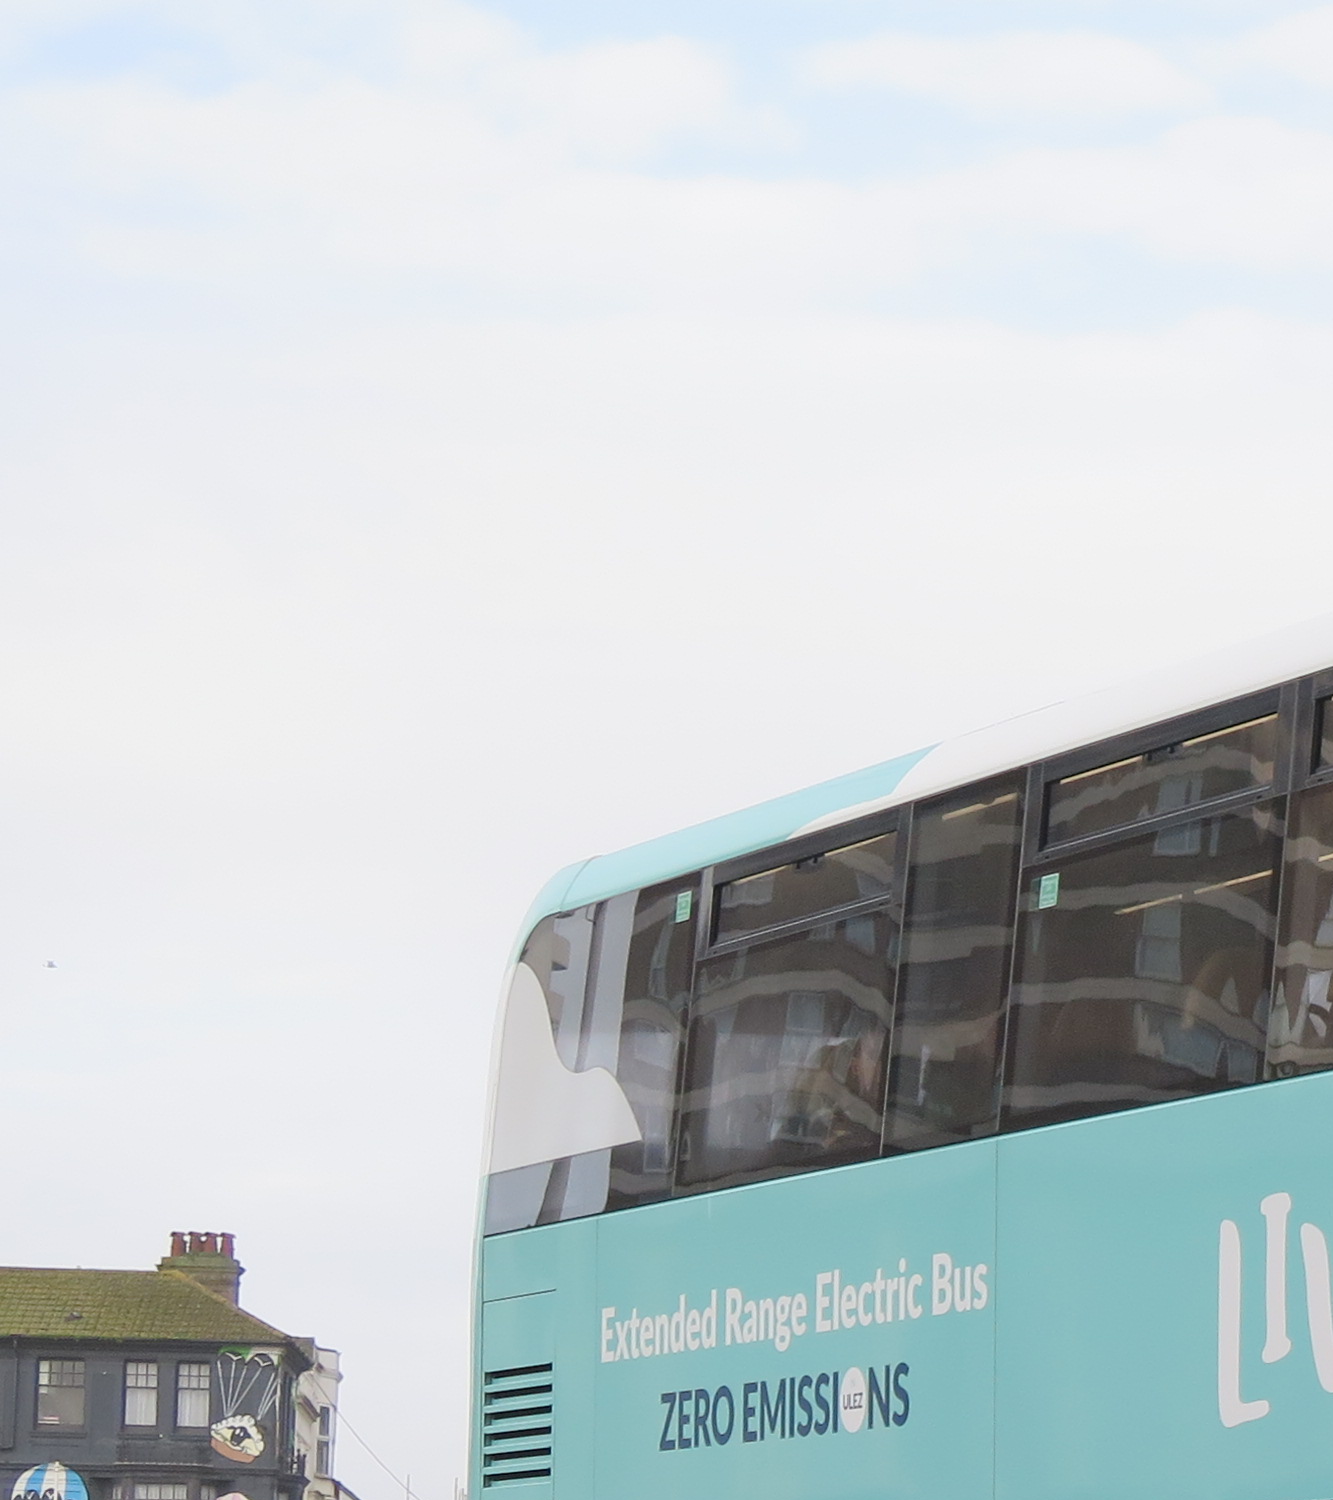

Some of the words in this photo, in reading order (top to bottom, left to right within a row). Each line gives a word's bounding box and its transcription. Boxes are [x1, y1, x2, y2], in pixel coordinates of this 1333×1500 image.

[601, 1289, 717, 1363] Extended
[725, 1288, 807, 1352] Range
[815, 1258, 922, 1333] Electric
[931, 1252, 988, 1316] Bus
[659, 1385, 735, 1451] ZERO
[843, 1392, 863, 1410] ULEZ
